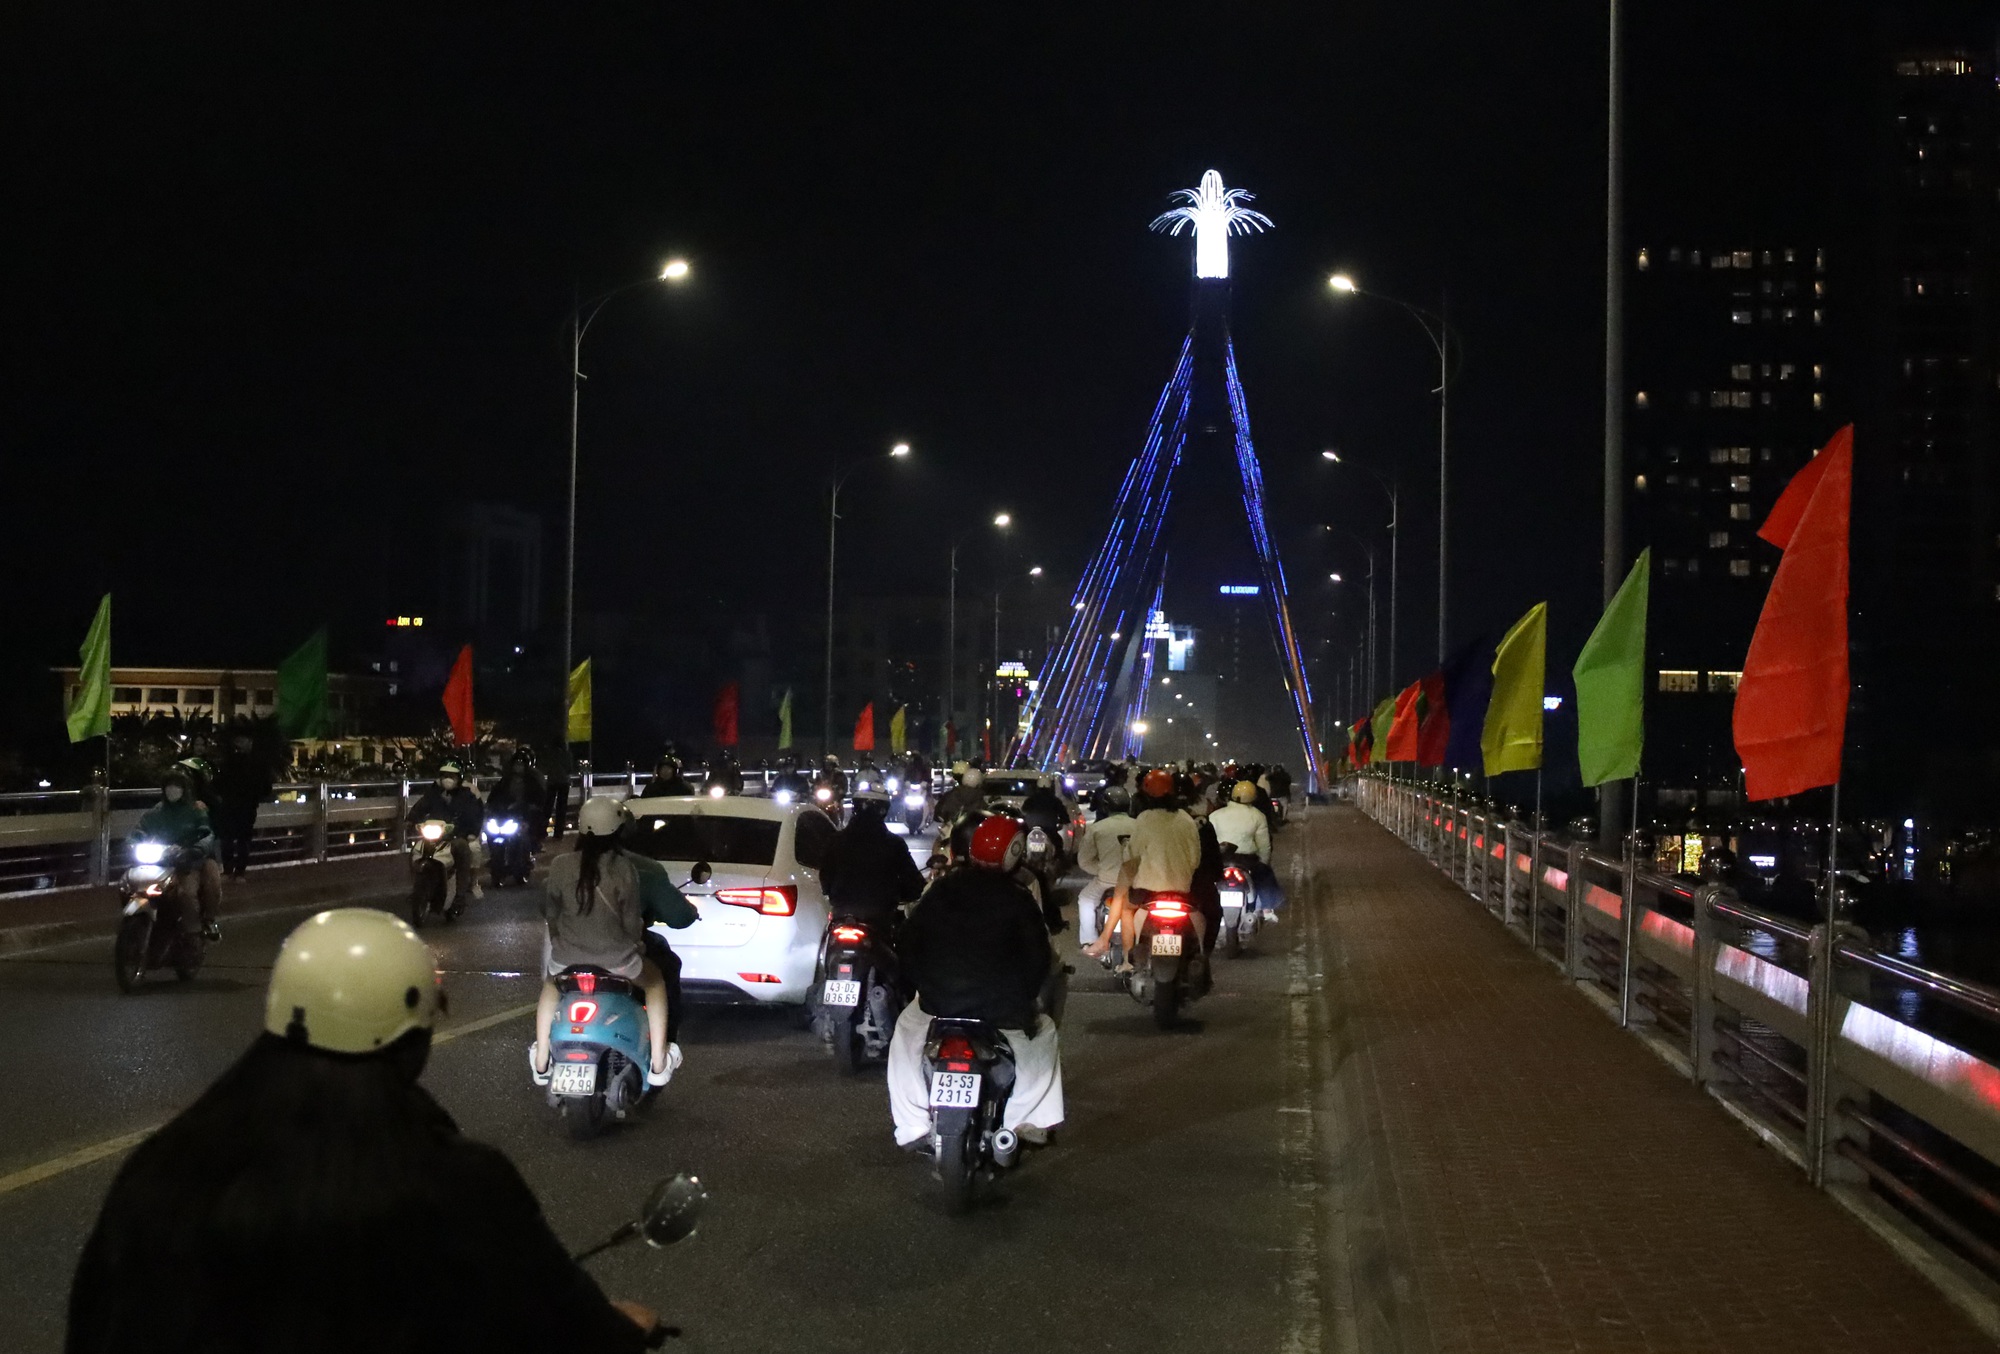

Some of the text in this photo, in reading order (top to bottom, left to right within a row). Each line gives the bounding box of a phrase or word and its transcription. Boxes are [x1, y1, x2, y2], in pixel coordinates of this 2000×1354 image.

[559, 1065, 590, 1078] 75-AF
[938, 1074, 974, 1089] 43-S3
[936, 1089, 972, 1104] 2315
